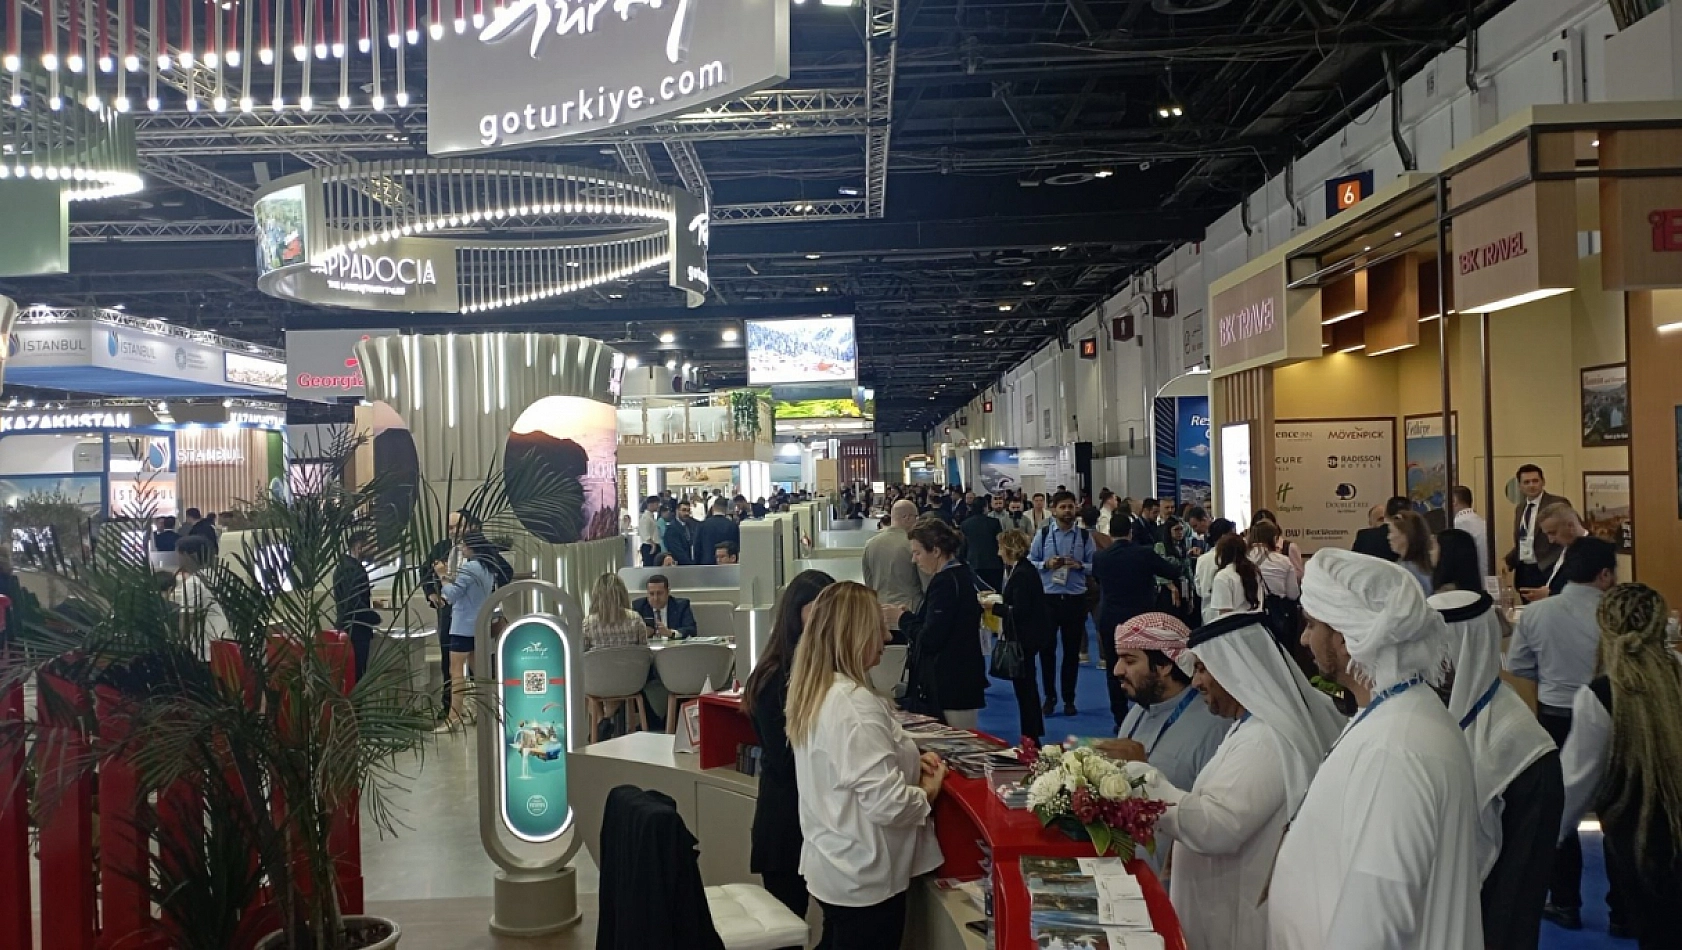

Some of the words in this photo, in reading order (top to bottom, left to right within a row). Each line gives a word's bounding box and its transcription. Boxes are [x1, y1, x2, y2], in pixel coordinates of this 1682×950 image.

[479, 60, 724, 146] goturkiye.com
[1343, 184, 1355, 205] 6
[1482, 231, 1528, 268] TRAVEL
[1236, 297, 1275, 341] TRAVEL
[1275, 431, 1299, 439] ence
[1275, 456, 1303, 465] CURE
